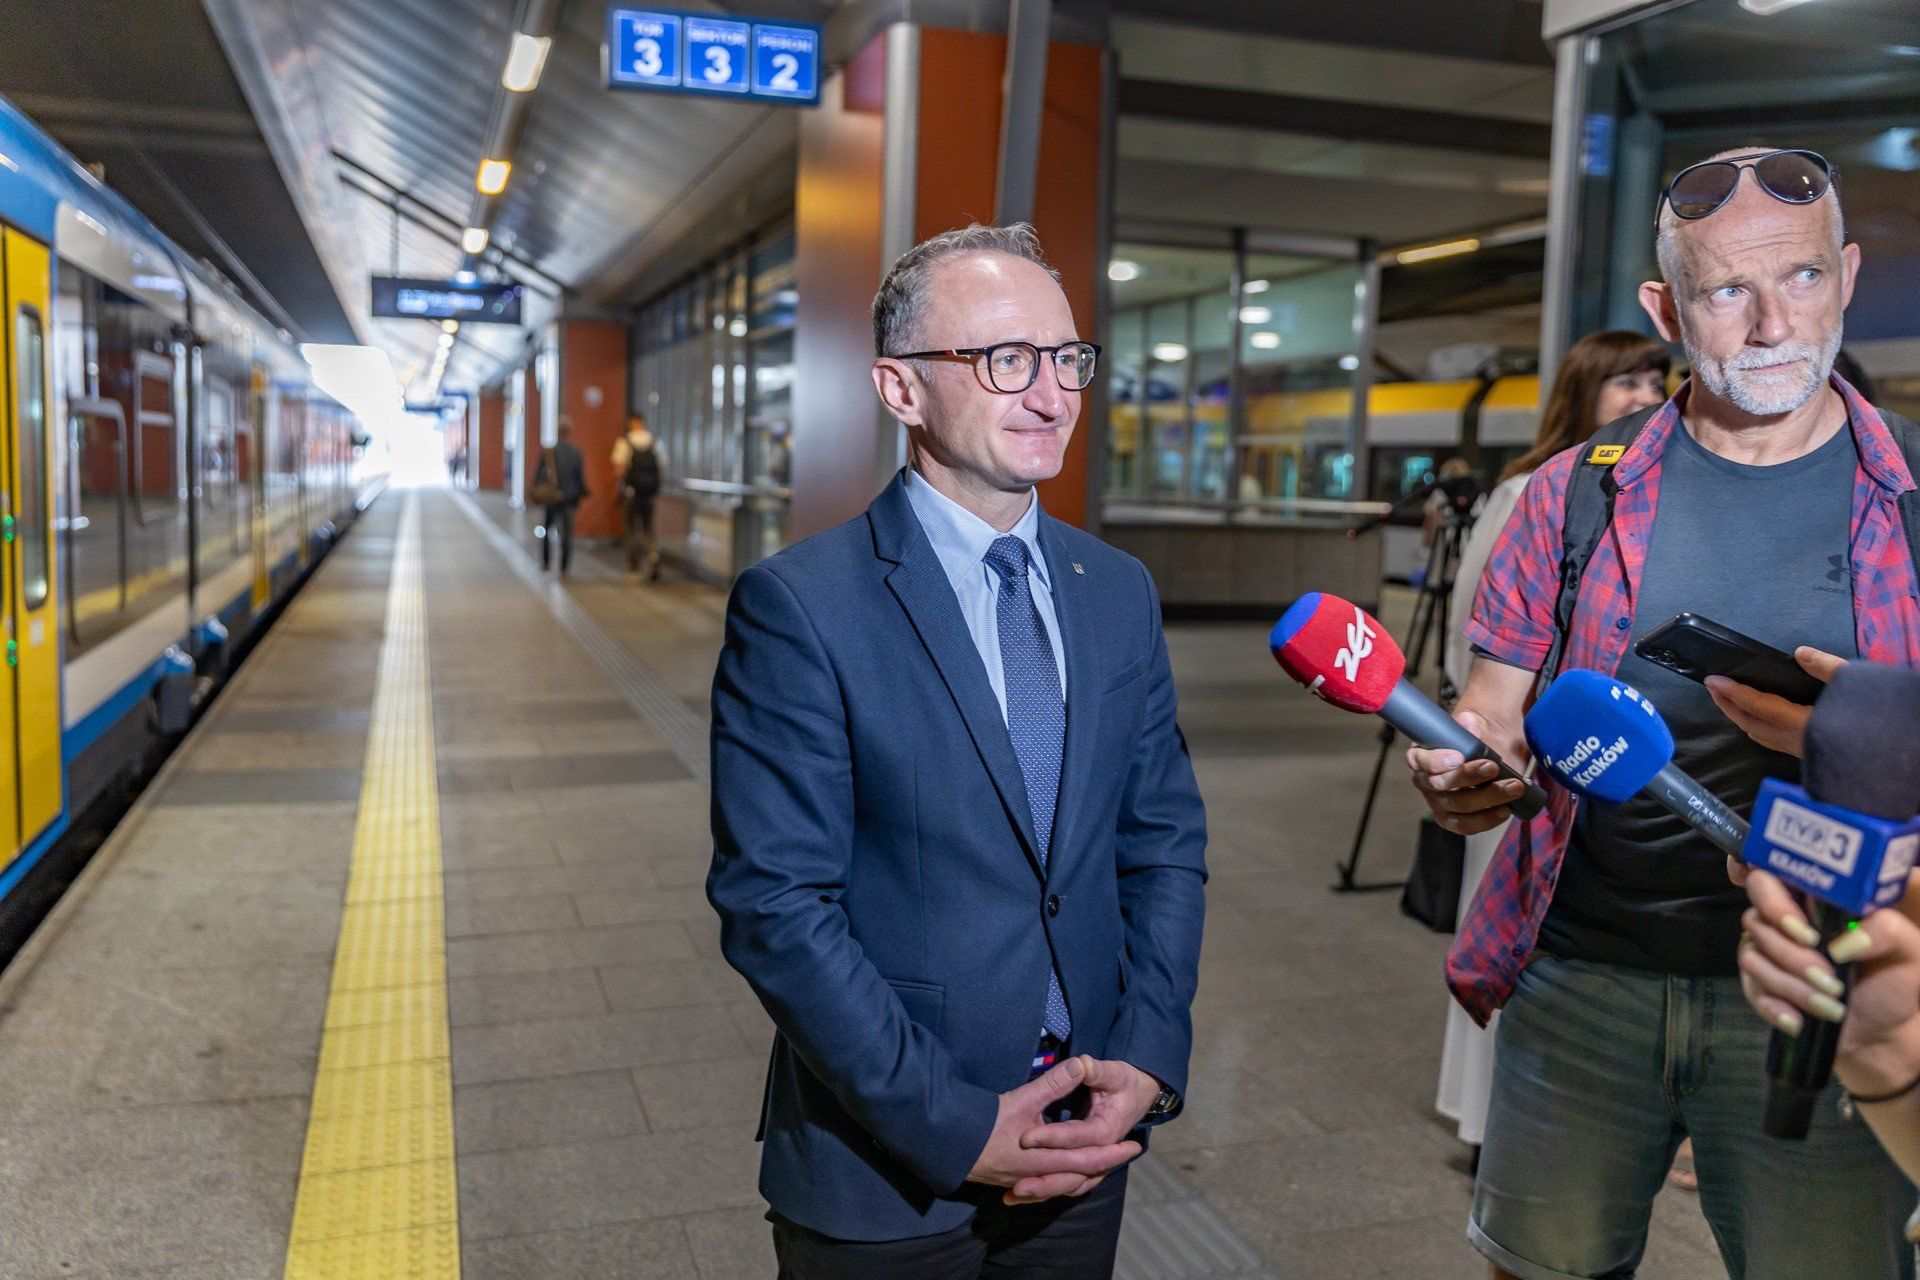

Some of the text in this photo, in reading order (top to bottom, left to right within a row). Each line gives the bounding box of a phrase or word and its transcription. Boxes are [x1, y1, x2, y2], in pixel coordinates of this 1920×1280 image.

[633, 38, 662, 77] 3
[703, 45, 732, 84] 3
[770, 53, 799, 92] 2
[1599, 449, 1618, 458] CAT
[1556, 735, 1601, 775] Radio
[1573, 735, 1630, 788] Kraków
